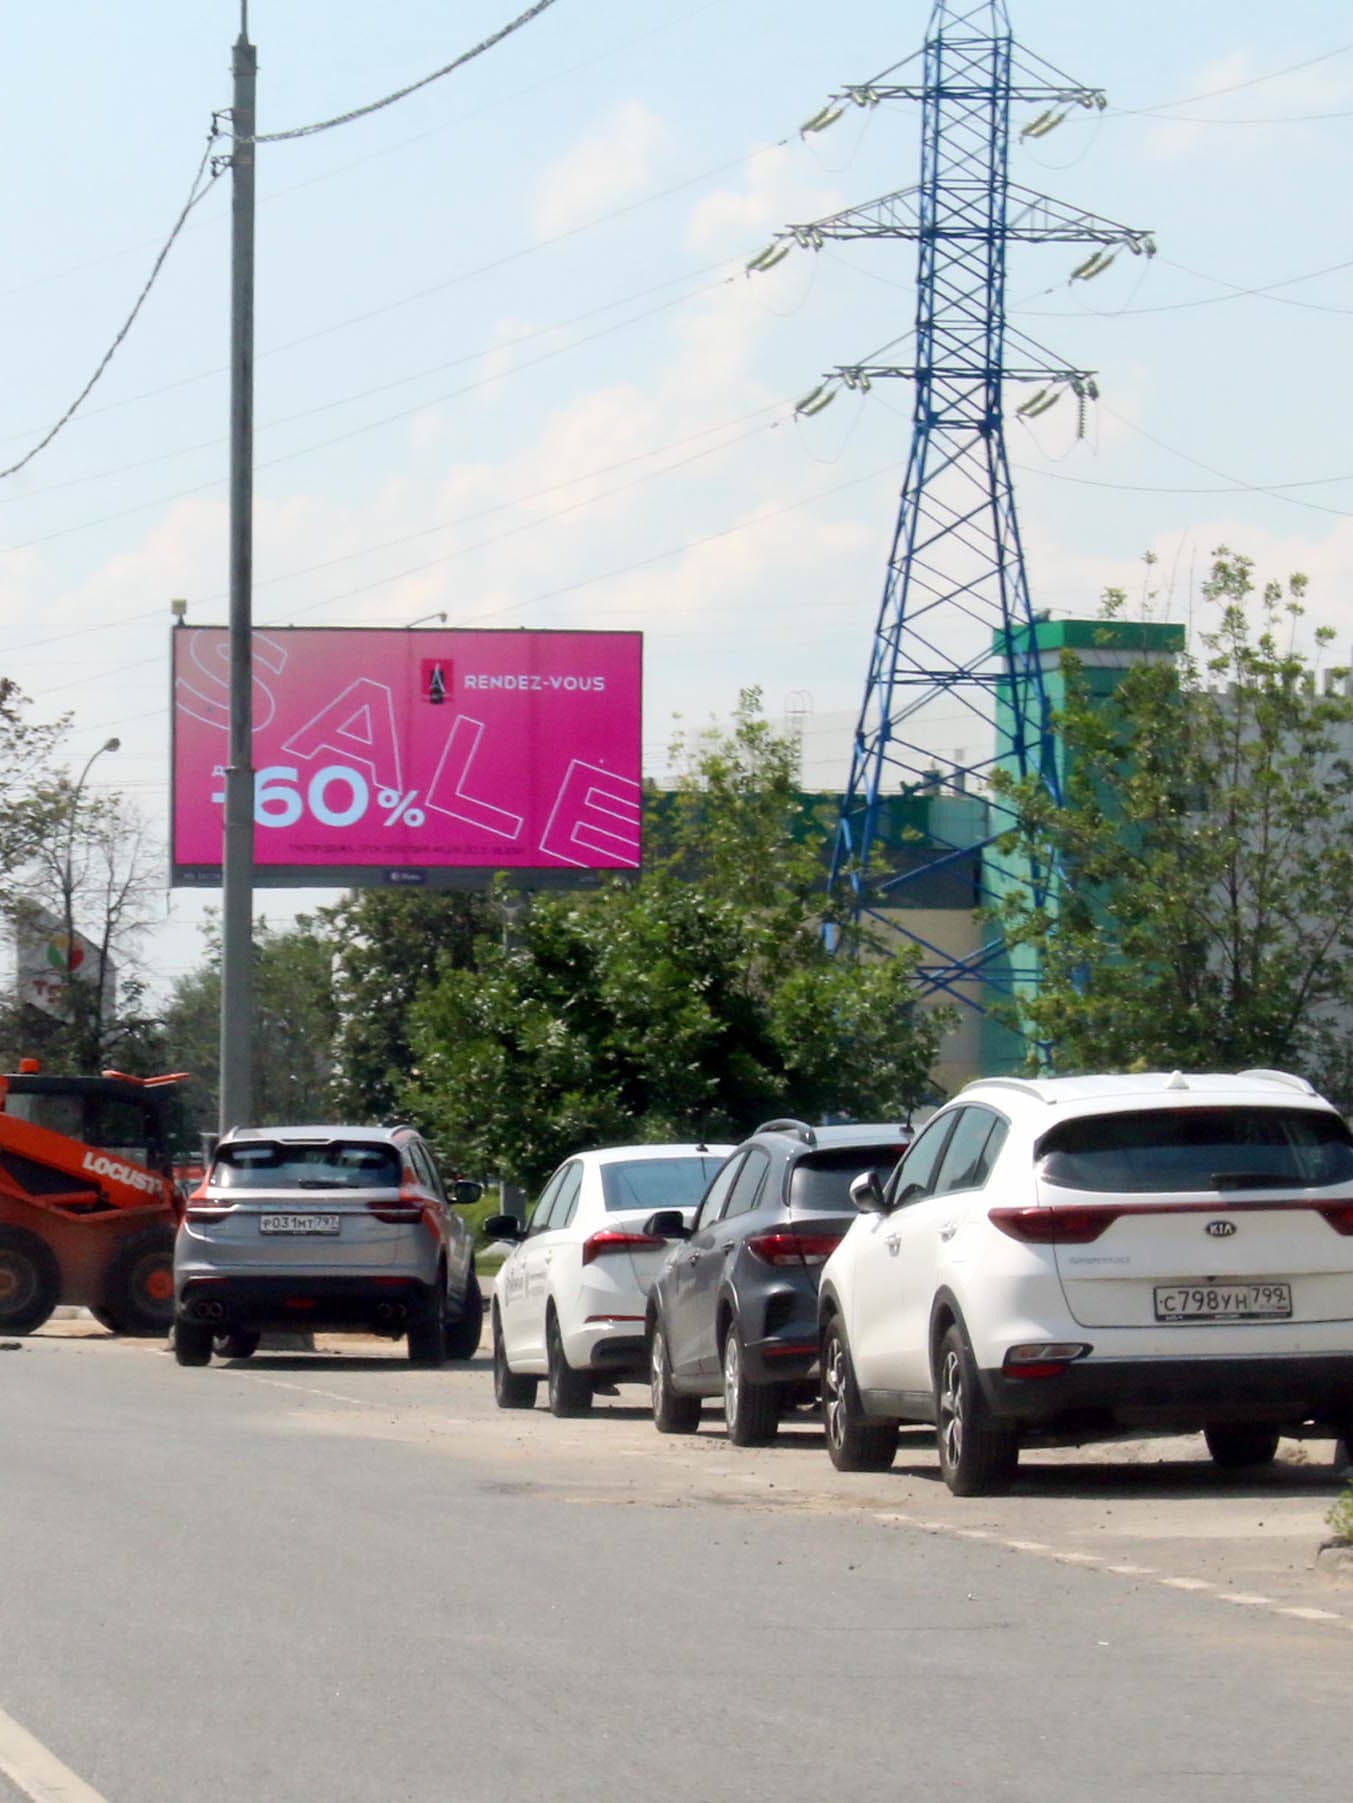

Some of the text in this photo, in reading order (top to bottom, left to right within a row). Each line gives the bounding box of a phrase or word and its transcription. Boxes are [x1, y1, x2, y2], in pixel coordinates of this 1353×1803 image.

[464, 674, 606, 691] RENDEZ-VOUS
[82, 1151, 163, 1194] LOCUST
[1208, 1223, 1234, 1235] KIA
[1163, 1287, 1284, 1312] С798УН 799
